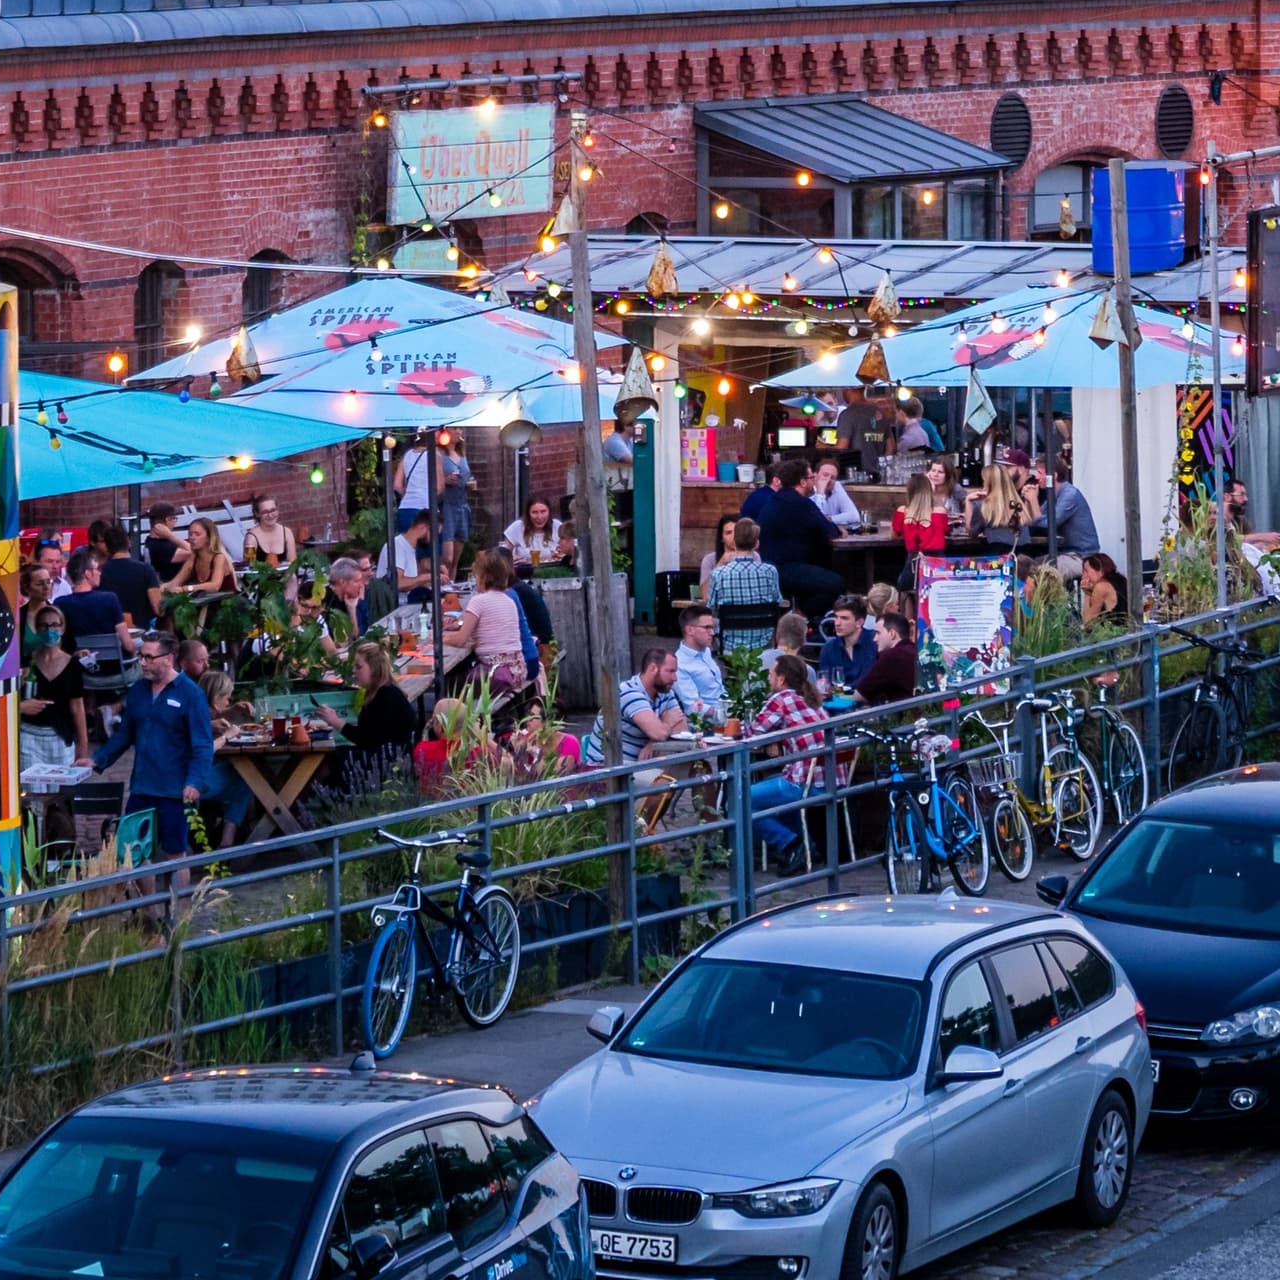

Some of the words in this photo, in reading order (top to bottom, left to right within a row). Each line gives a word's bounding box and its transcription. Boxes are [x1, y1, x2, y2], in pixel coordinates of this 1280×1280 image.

[313, 305, 395, 315] AMERICAN
[309, 314, 391, 327] SPIRIT
[365, 361, 457, 375] SPIRIT
[600, 1233, 623, 1255] QE
[626, 1236, 673, 1260] 7753
